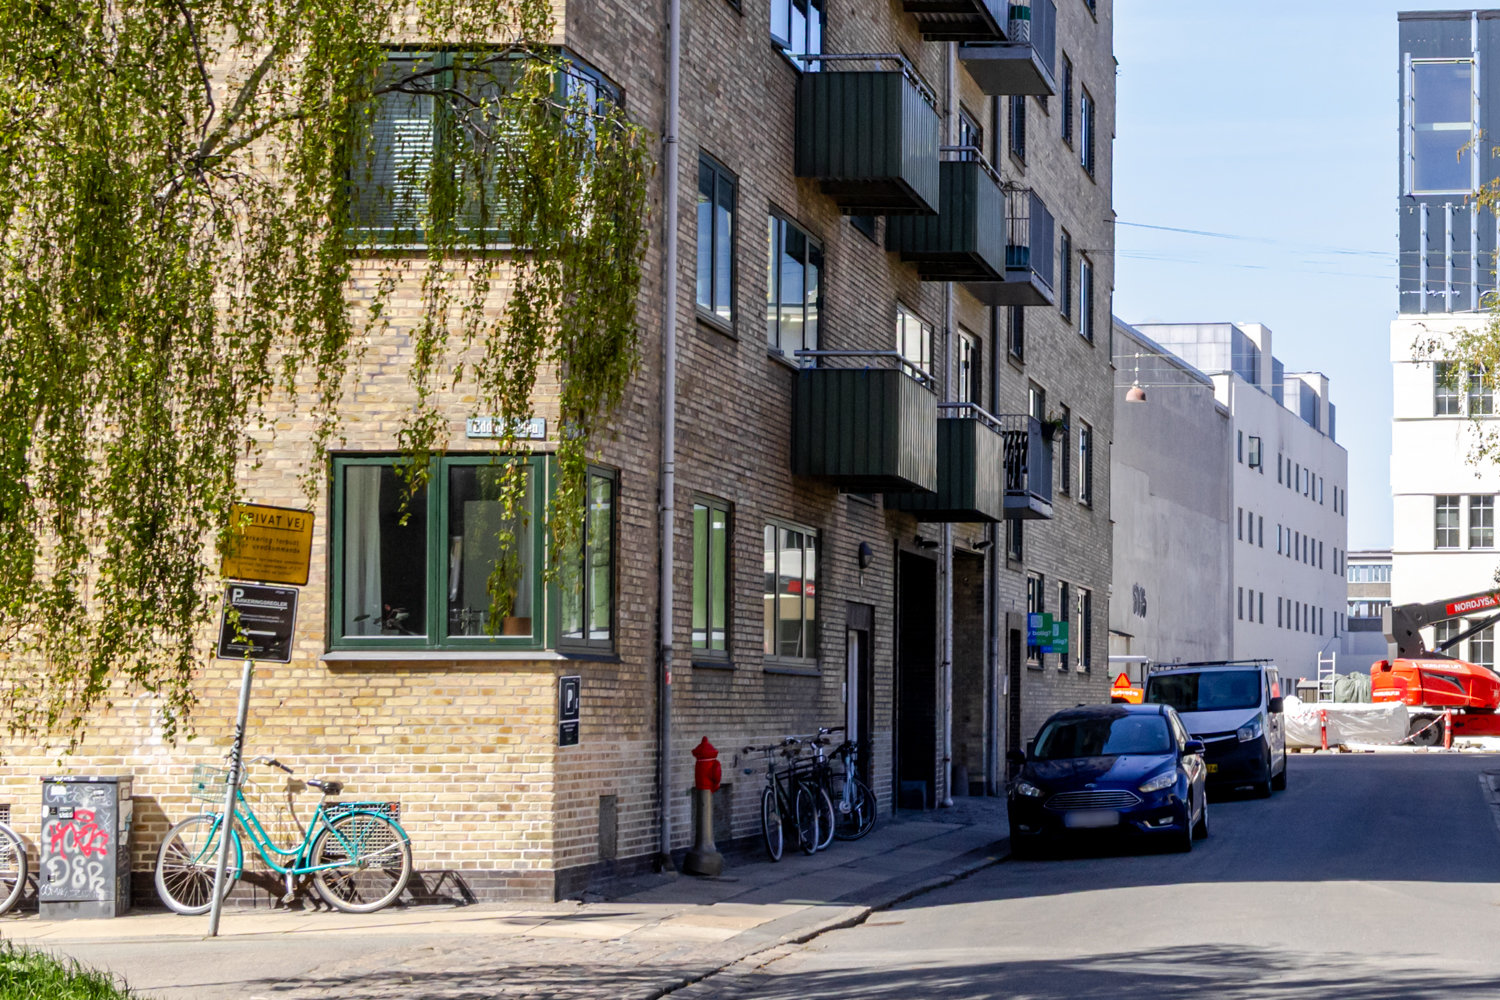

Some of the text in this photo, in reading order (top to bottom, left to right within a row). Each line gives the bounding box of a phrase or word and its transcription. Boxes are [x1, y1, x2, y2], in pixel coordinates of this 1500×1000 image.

[287, 517, 305, 529] VEJ
[241, 535, 272, 544] arkering
[1454, 596, 1496, 613] NORDJYSK
